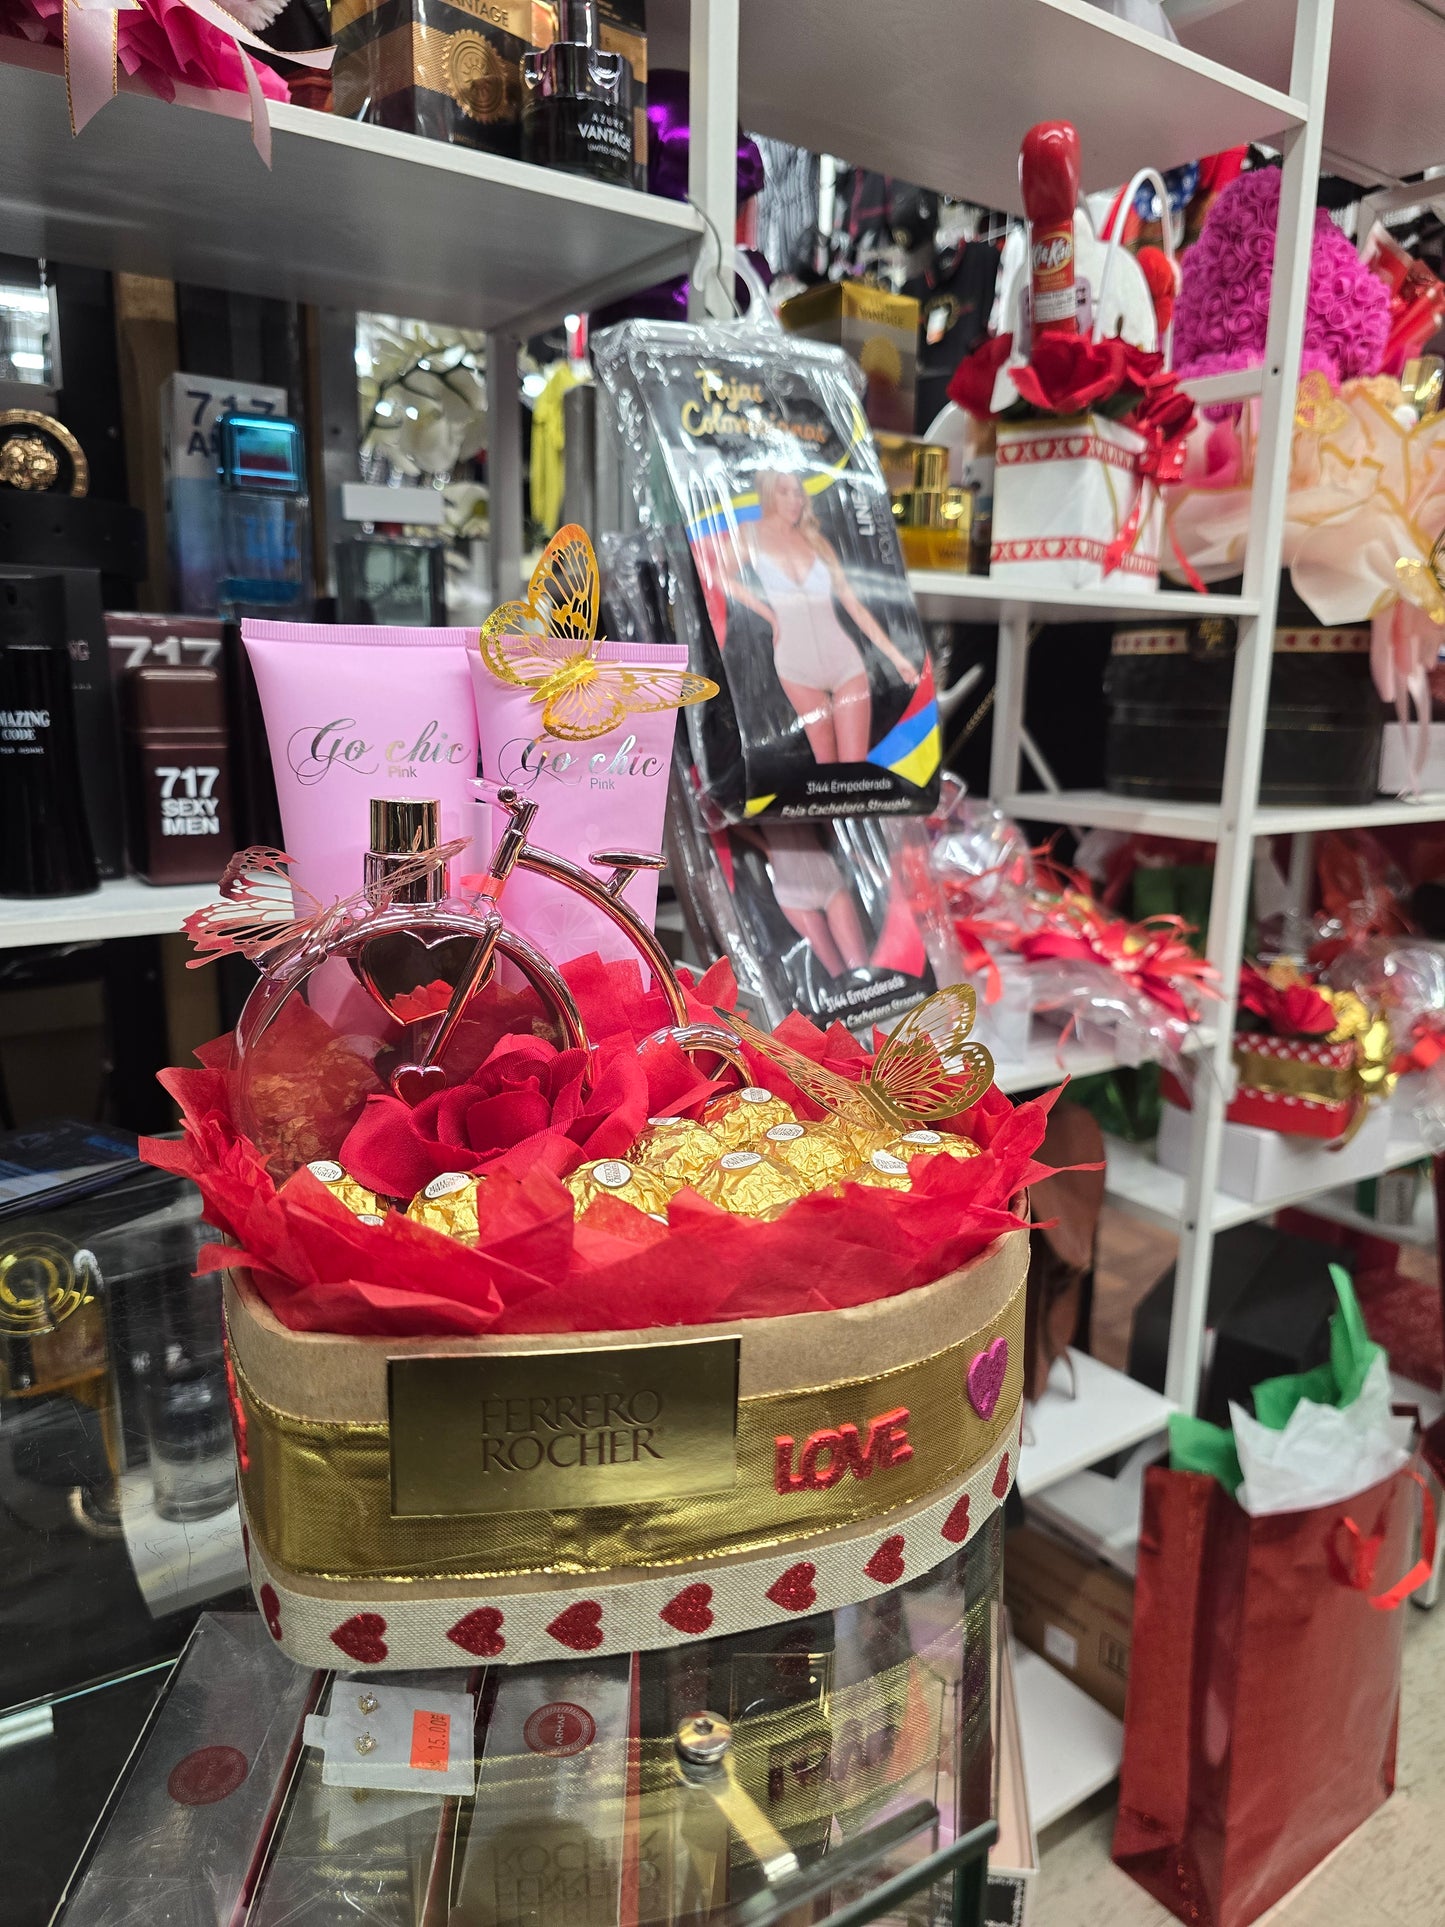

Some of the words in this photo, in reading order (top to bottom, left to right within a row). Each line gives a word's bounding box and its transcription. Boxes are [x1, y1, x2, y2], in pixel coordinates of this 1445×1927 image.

[287, 718, 380, 786] Go
[385, 720, 472, 766] chic
[498, 733, 583, 793] Go
[588, 735, 665, 778] chic
[155, 766, 220, 798] 717
[388, 765, 418, 779] Pink
[590, 778, 616, 790] Pink
[830, 777, 893, 794] Empoderada
[161, 798, 219, 817] SEXY
[161, 816, 220, 836] MEN
[846, 974, 907, 1006] Empoderada
[612, 1163, 621, 1183] FERRERO
[482, 1390, 663, 1437] FERRERO
[482, 1429, 664, 1474] ROCHER
[774, 1406, 913, 1496] LOVE
[555, 1713, 566, 1746] ARMAF
